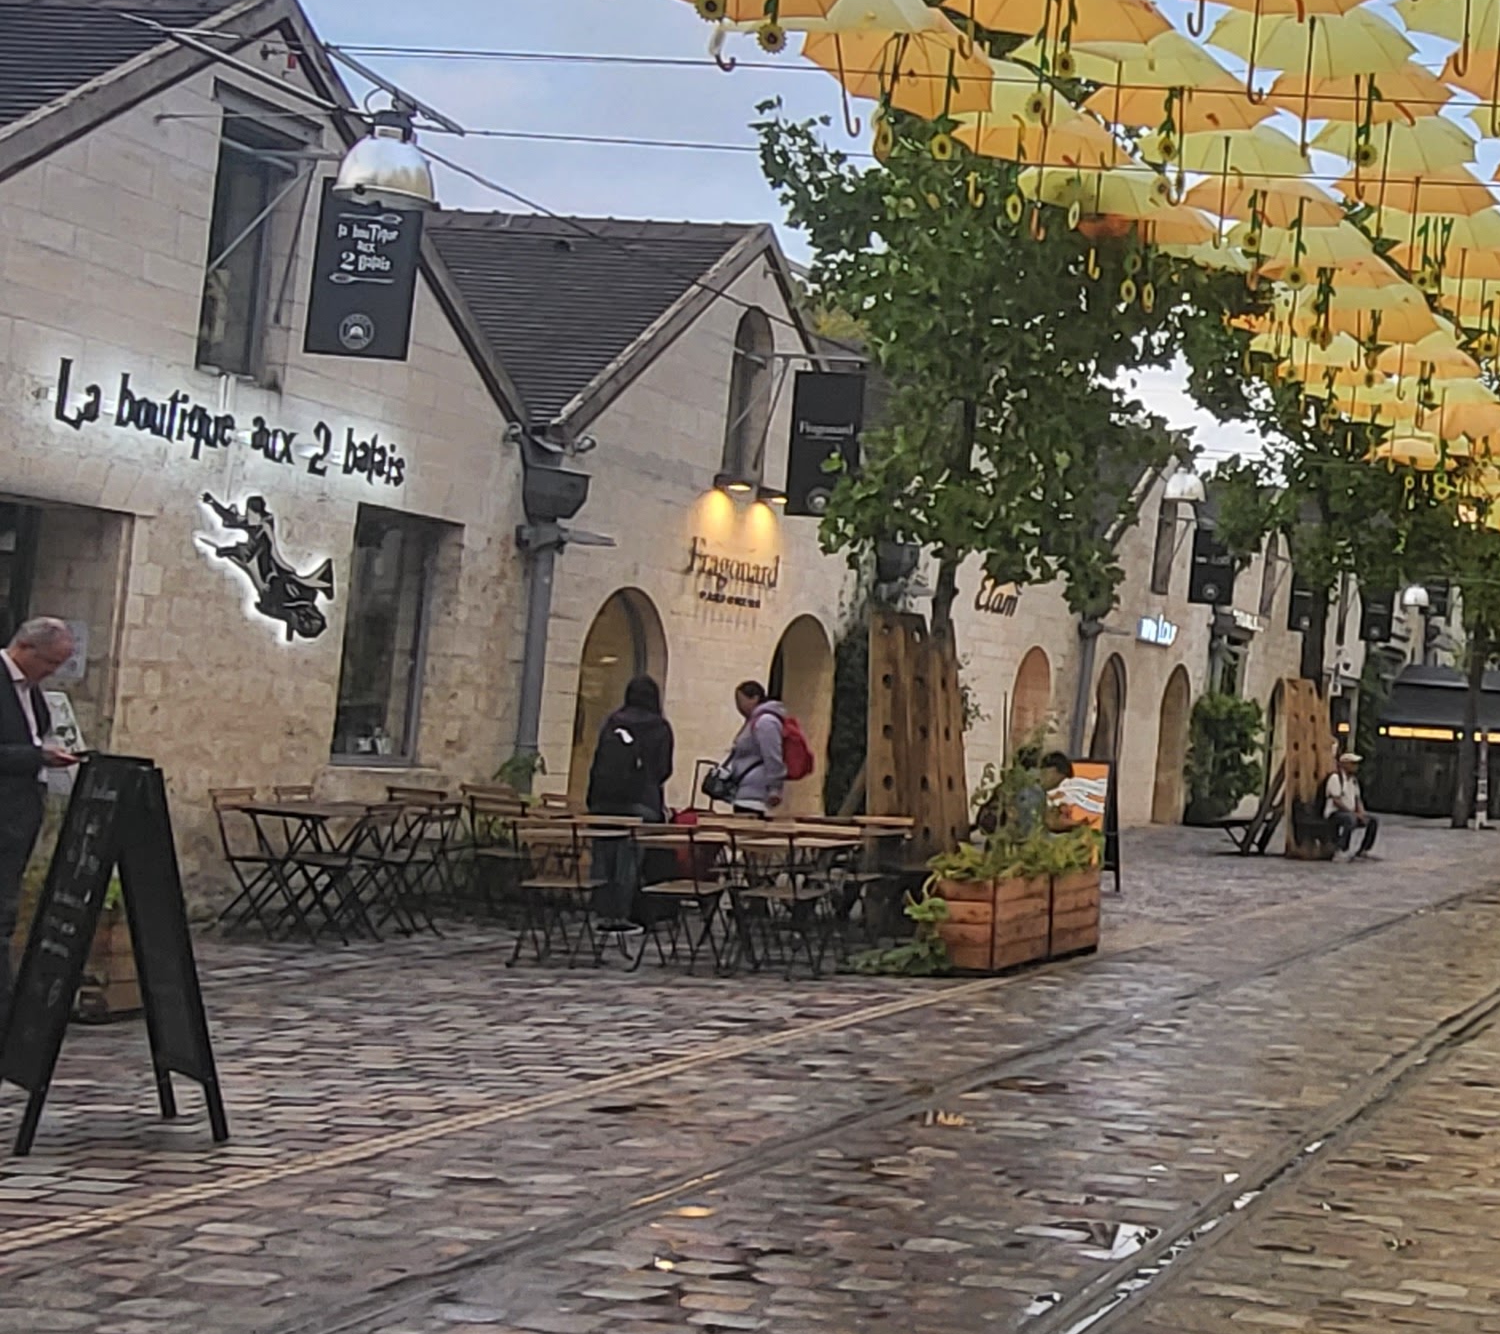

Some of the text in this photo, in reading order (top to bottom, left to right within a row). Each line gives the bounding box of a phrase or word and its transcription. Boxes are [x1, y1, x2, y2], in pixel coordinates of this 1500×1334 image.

[340, 251, 356, 271] 2
[54, 357, 405, 487] La boutique aux 2 balais
[683, 535, 780, 592] Fragonard
